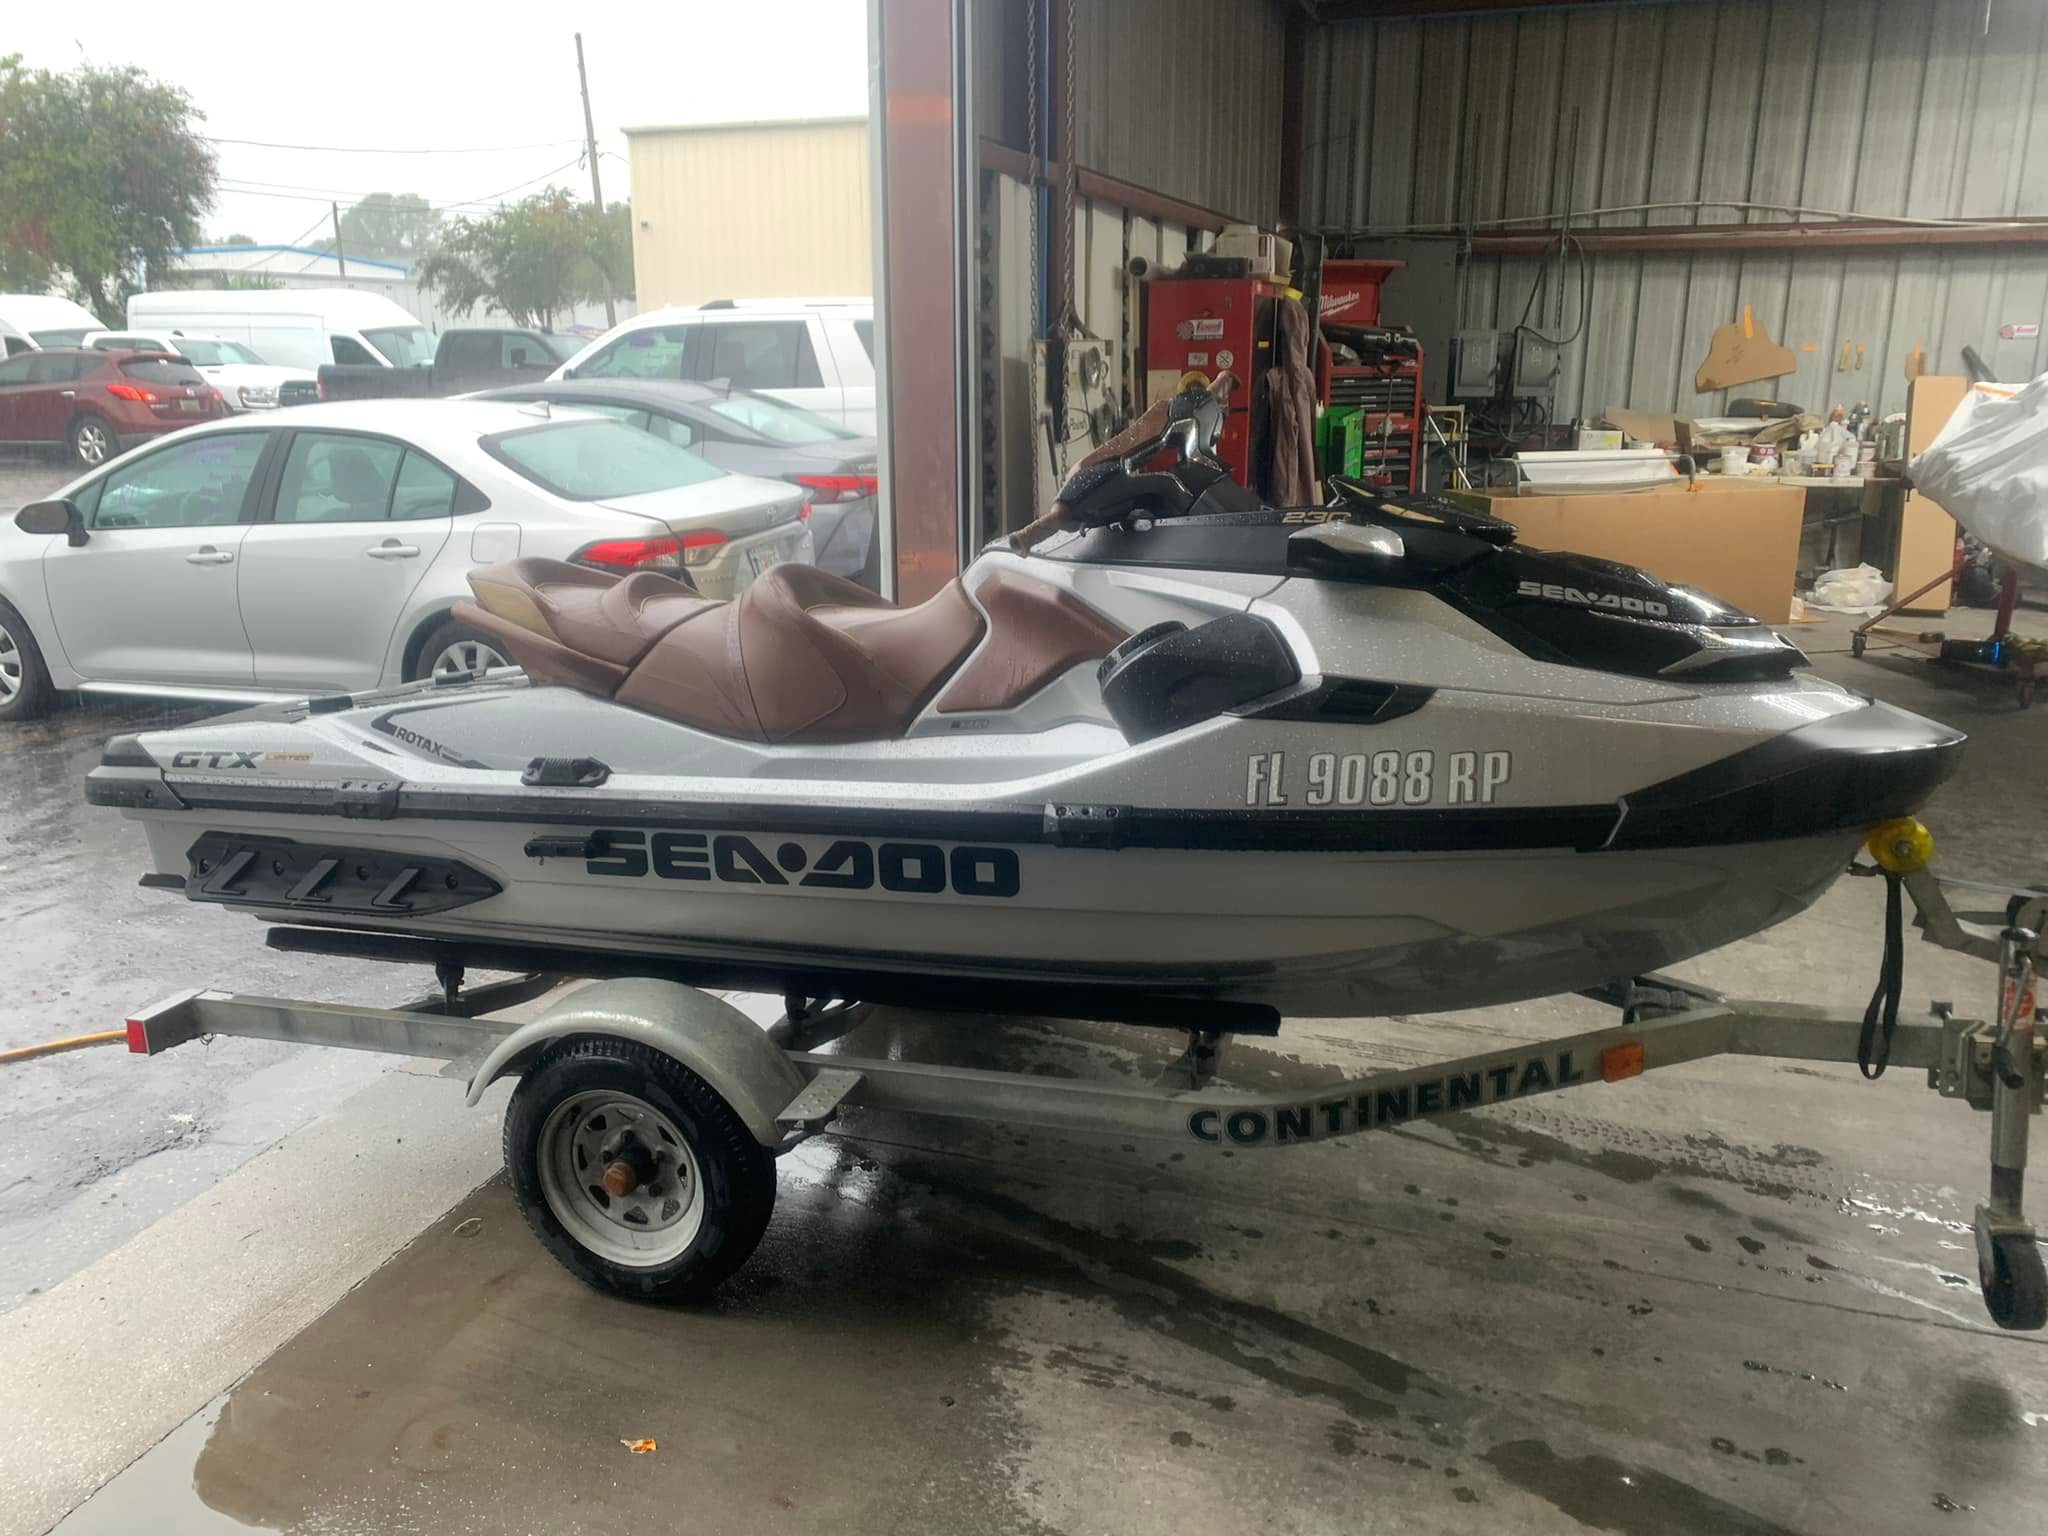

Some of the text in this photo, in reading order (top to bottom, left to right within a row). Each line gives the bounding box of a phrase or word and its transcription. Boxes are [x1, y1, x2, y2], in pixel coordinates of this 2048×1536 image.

[172, 751, 264, 769] GTX
[396, 726, 442, 757] ROTAX
[1246, 750, 1512, 806] FL 9088 RP
[1187, 1051, 1584, 1145] CONTINENTAL
